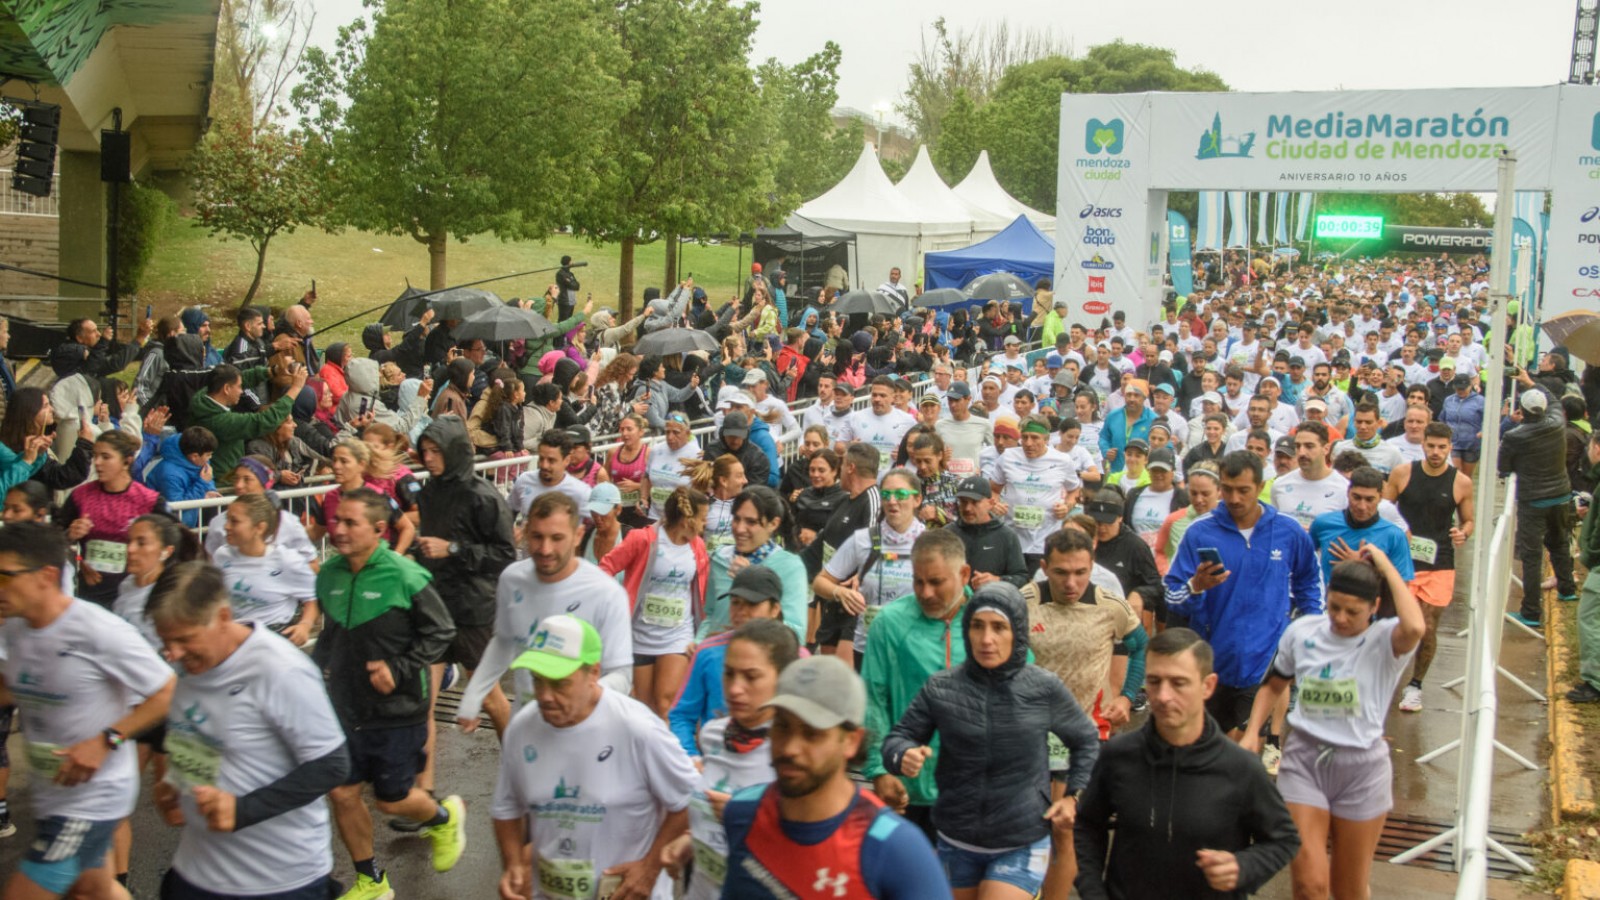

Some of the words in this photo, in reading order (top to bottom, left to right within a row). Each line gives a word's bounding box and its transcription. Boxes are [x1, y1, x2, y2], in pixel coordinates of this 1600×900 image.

[1266, 108, 1509, 138] MediaMaratón
[1266, 140, 1347, 160] Ciudad
[1354, 140, 1385, 159] de
[1076, 157, 1131, 168] mendoza
[1084, 170, 1121, 180] ciudad
[1279, 173, 1355, 182] ANIVERSARIO
[1359, 174, 1372, 182] 10
[1375, 172, 1408, 182] AÑOS
[1093, 207, 1122, 218] asics
[1086, 225, 1110, 236] bon
[1319, 221, 1380, 233] 00:00:39
[1083, 236, 1116, 247] aqua
[1302, 688, 1354, 704] B2799
